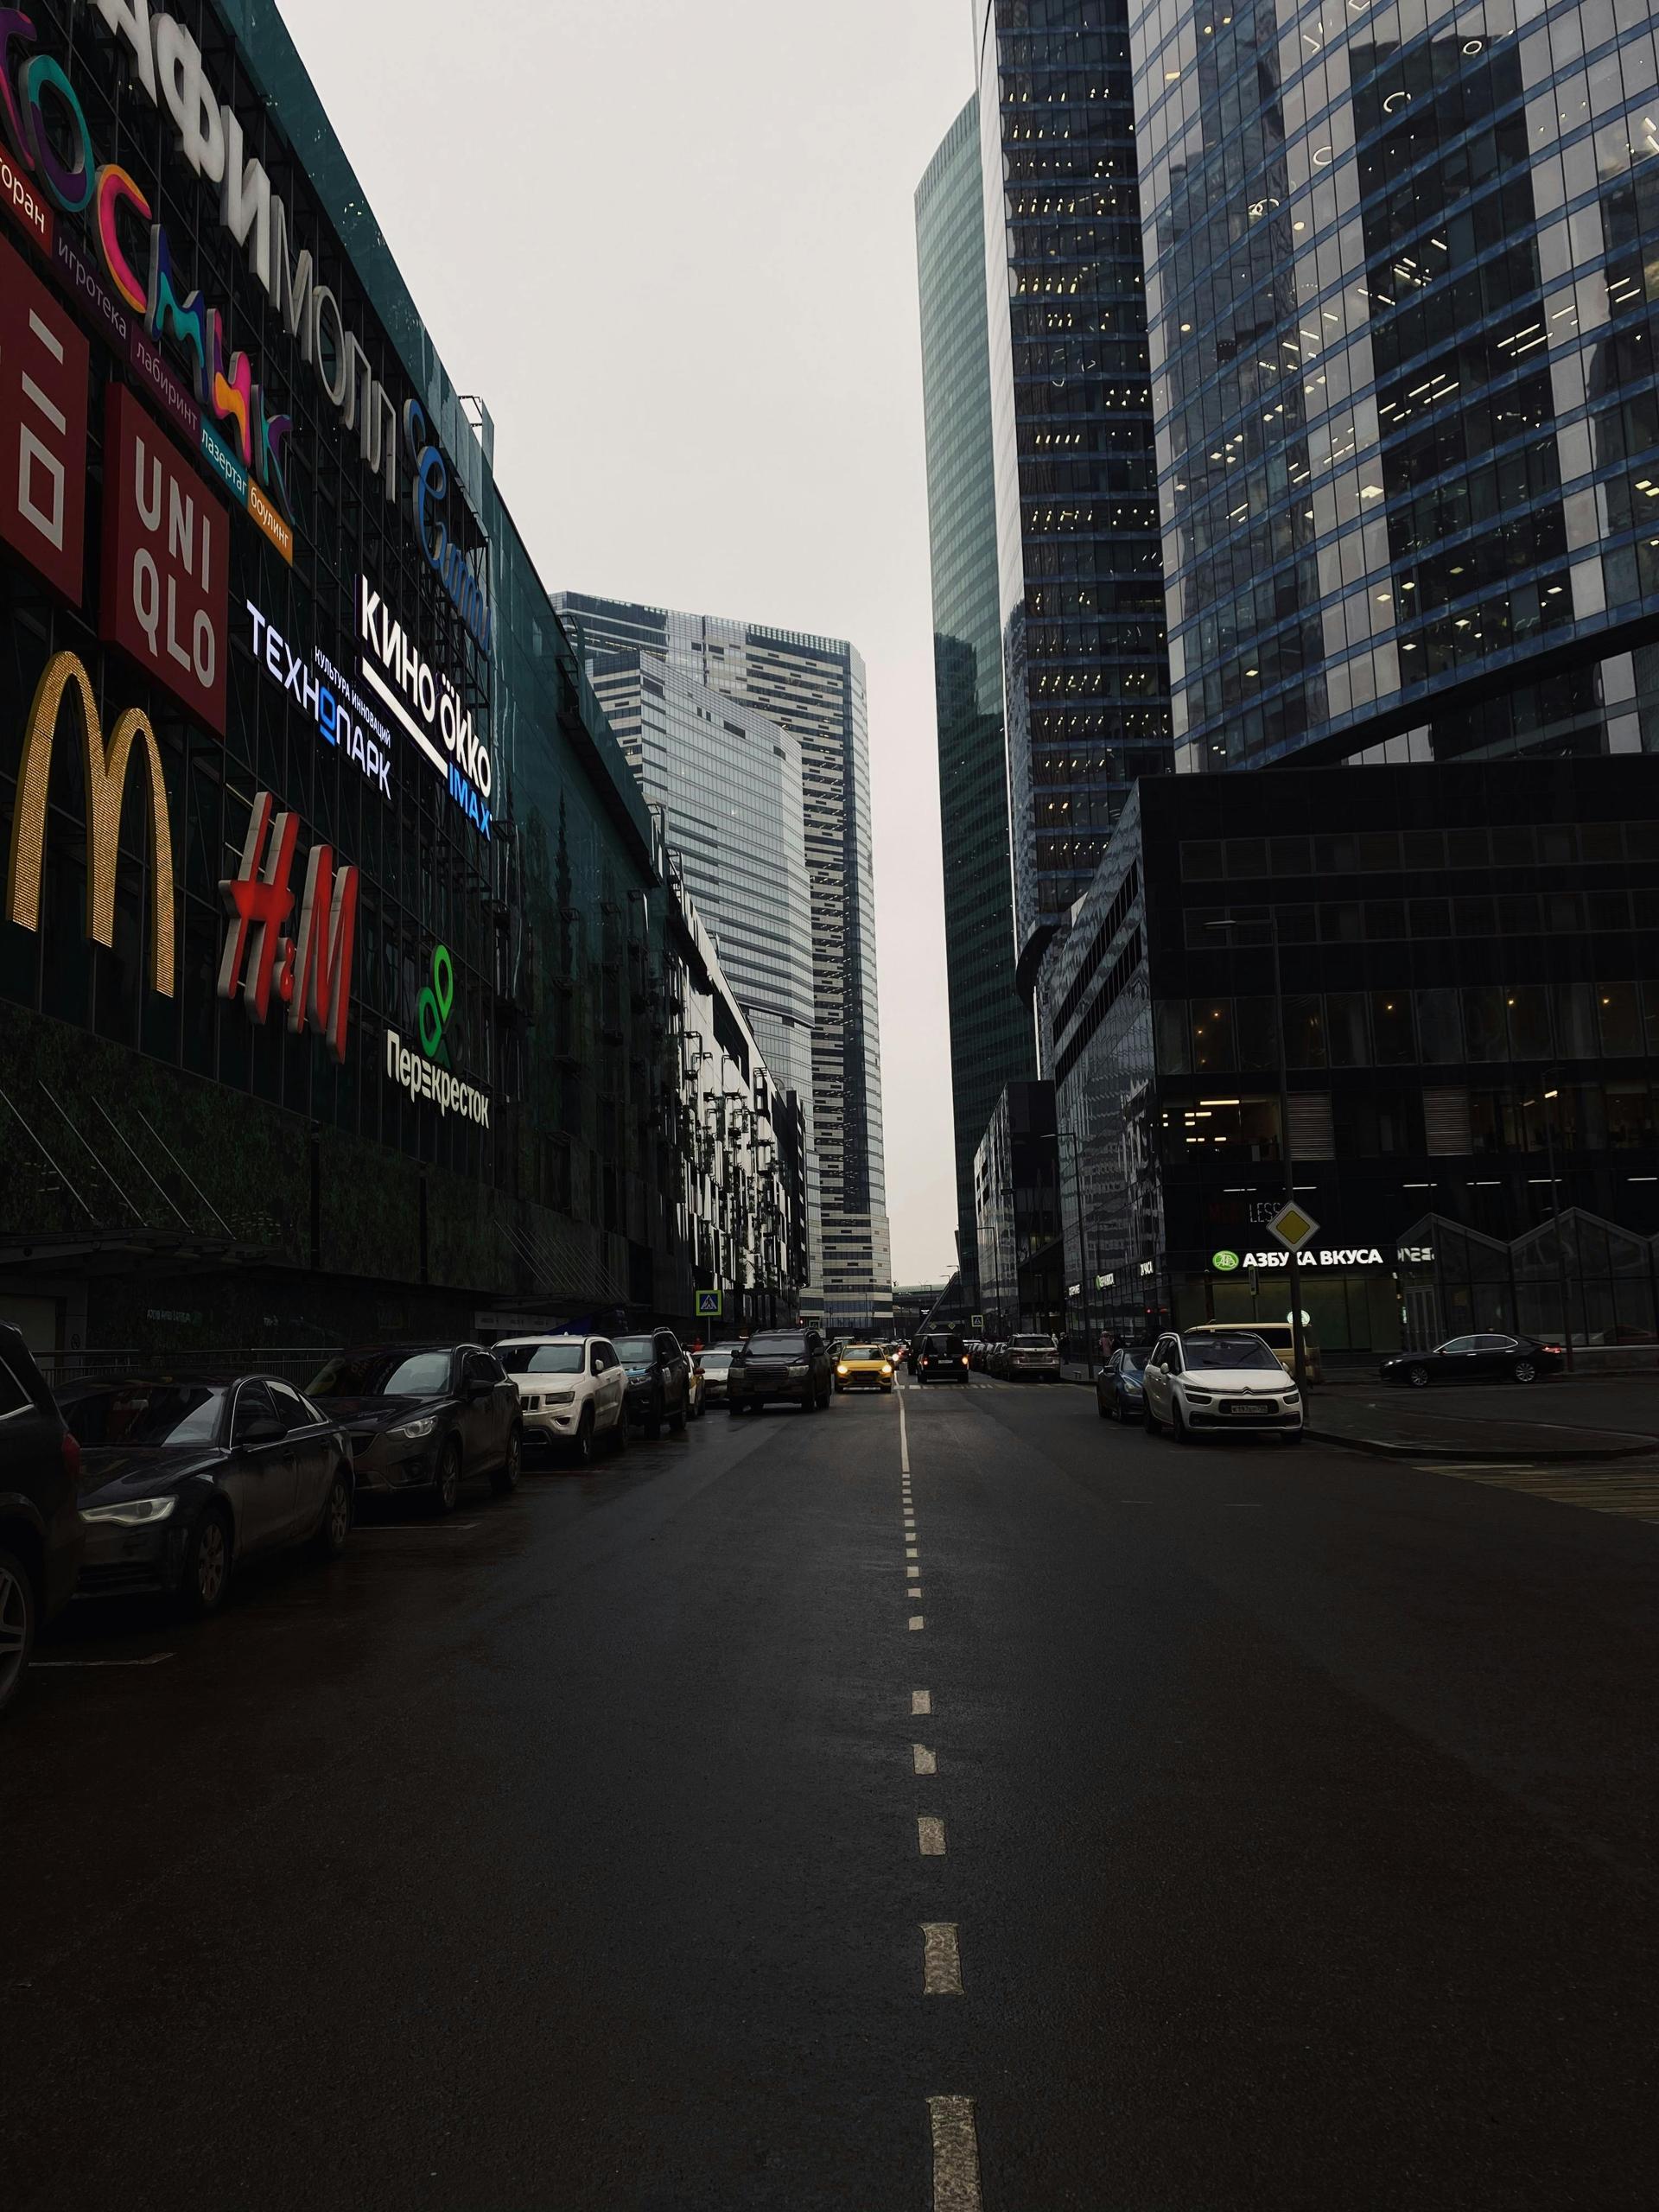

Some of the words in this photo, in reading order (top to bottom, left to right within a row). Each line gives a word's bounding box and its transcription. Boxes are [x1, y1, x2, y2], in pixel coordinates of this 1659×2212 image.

[58, 238, 127, 340] игротека
[136, 342, 198, 431] лабиринт
[135, 435, 211, 594] UNI
[201, 429, 247, 497] лазертаг
[250, 486, 289, 549] боулинг
[132, 547, 216, 689] QLO
[362, 574, 435, 723] КИНО
[246, 599, 391, 800] ТЕХНОПАРК
[315, 645, 351, 702] КУЛЬТУРА
[351, 690, 391, 749] ИННОВАЦИЙ
[217, 791, 359, 1065] H&M
[386, 1028, 490, 1130] Перекресток
[1319, 1249, 1384, 1265] ВКУСА
